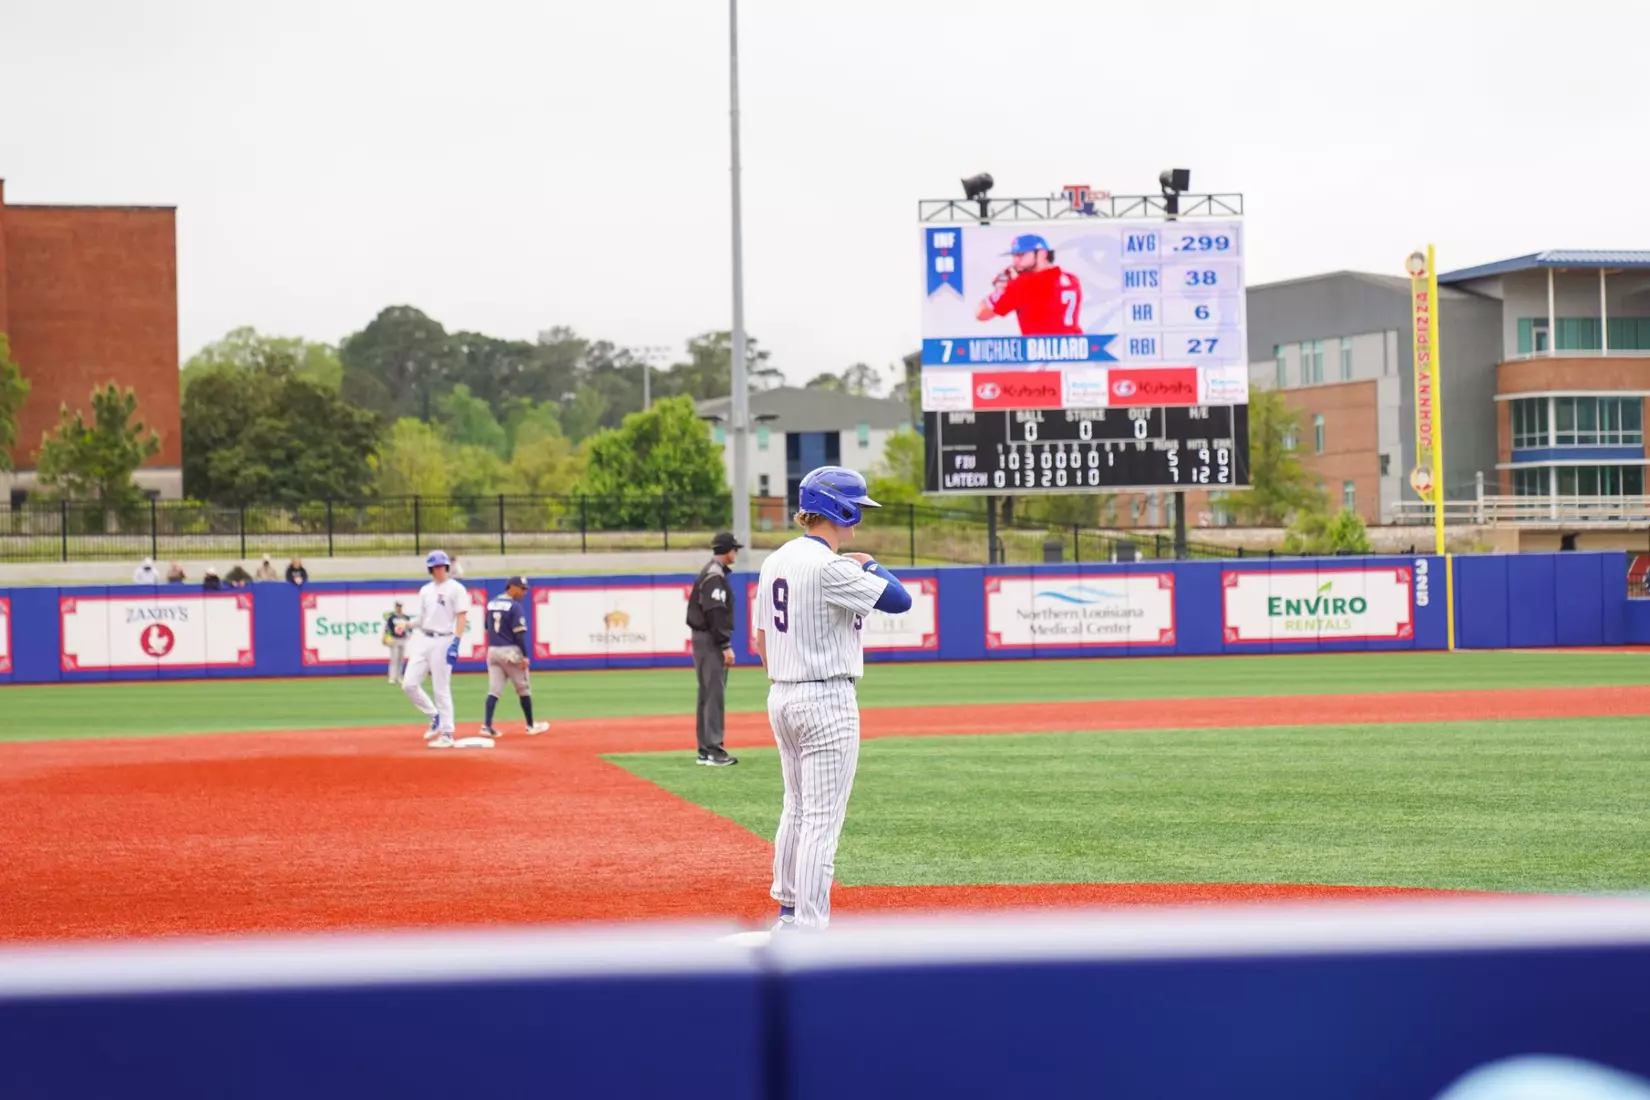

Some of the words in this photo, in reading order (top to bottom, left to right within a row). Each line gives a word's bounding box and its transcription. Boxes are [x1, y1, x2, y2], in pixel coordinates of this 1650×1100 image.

[1127, 234, 1155, 252] AVG
[1173, 236, 1229, 251] .299
[1125, 270, 1158, 288] HITS
[1185, 270, 1217, 286] 38
[1061, 290, 1077, 325] 7
[1132, 304, 1153, 321] HR
[1194, 304, 1210, 320] 6
[1416, 292, 1429, 344] PIZZA
[940, 340, 953, 363] 7
[969, 338, 1024, 362] MICHAEL
[1027, 337, 1089, 361] BALLARD
[1129, 338, 1155, 355] RBI
[1187, 338, 1219, 354] 27
[1001, 384, 1057, 398] Kubota
[1138, 380, 1194, 396] Kubota
[1418, 352, 1433, 447] JOHNNY'S
[949, 411, 975, 425] MPH
[1016, 409, 1045, 423] BALL
[1065, 408, 1105, 422] STRIKE
[1128, 408, 1152, 420] OUT
[1189, 407, 1209, 419] H/E
[1025, 420, 1038, 441] 0
[1079, 420, 1092, 440] 0
[1134, 419, 1147, 440] 0
[1186, 438, 1208, 450] HITS
[955, 454, 976, 470] FIU
[1008, 451, 1020, 470] 0
[1024, 451, 1035, 470] 3
[1041, 451, 1052, 470] 0
[1055, 451, 1067, 470] 0
[1070, 450, 1081, 469] 0
[1087, 450, 1099, 468] 0
[1108, 451, 1114, 467] 1
[1167, 449, 1179, 466] 5
[1198, 448, 1210, 465] 9
[1217, 448, 1229, 465] 0
[945, 472, 988, 488] LATECH
[994, 470, 1005, 488] 0
[1014, 470, 1020, 486] 1
[1024, 469, 1035, 488] 3
[1041, 469, 1052, 487] 2
[1056, 469, 1067, 487] 0
[1076, 469, 1082, 486] 1
[1088, 468, 1100, 486] 0
[1168, 466, 1179, 483] 7
[1217, 465, 1229, 483] 2
[125, 605, 189, 623] ZAXBY'S
[772, 577, 789, 633] 9
[1016, 607, 1080, 621] Northern
[1082, 605, 1145, 619] Louisiana
[1268, 595, 1368, 616] ENVIRO
[315, 616, 382, 641] Super
[1030, 621, 1083, 636] Medical
[1086, 621, 1132, 635] Center
[1285, 618, 1352, 632] RENTALS
[589, 633, 647, 645] TRENTON
